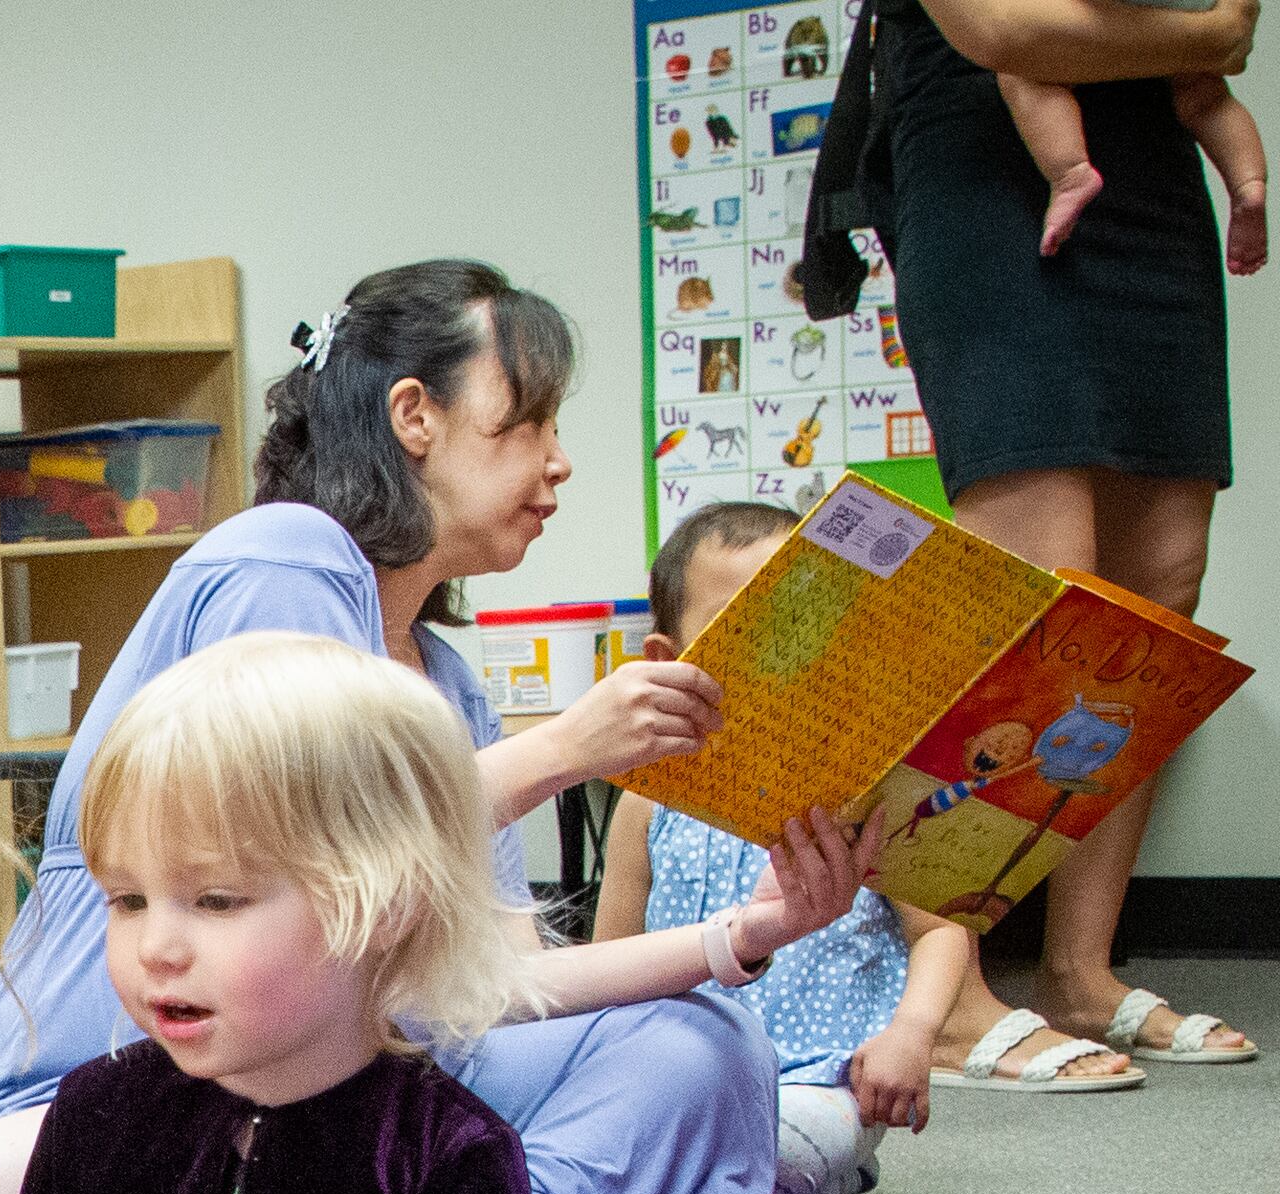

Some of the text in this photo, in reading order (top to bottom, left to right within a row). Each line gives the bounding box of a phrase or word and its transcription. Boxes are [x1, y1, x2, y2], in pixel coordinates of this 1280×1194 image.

[748, 11, 778, 35] Bb
[653, 28, 685, 49] Aa
[749, 89, 770, 112] Ff
[655, 103, 681, 126] Ee
[748, 168, 765, 196] Jj
[659, 255, 698, 277] Mm
[751, 243, 785, 267] Nn
[753, 322, 777, 343] Rr
[850, 311, 874, 334] Ss
[660, 330, 695, 355] Qq
[753, 398, 781, 417] Vv
[850, 389, 897, 409] Ww
[660, 406, 690, 427] Uu
[662, 476, 690, 506] Yy
[756, 473, 785, 494] Zz
